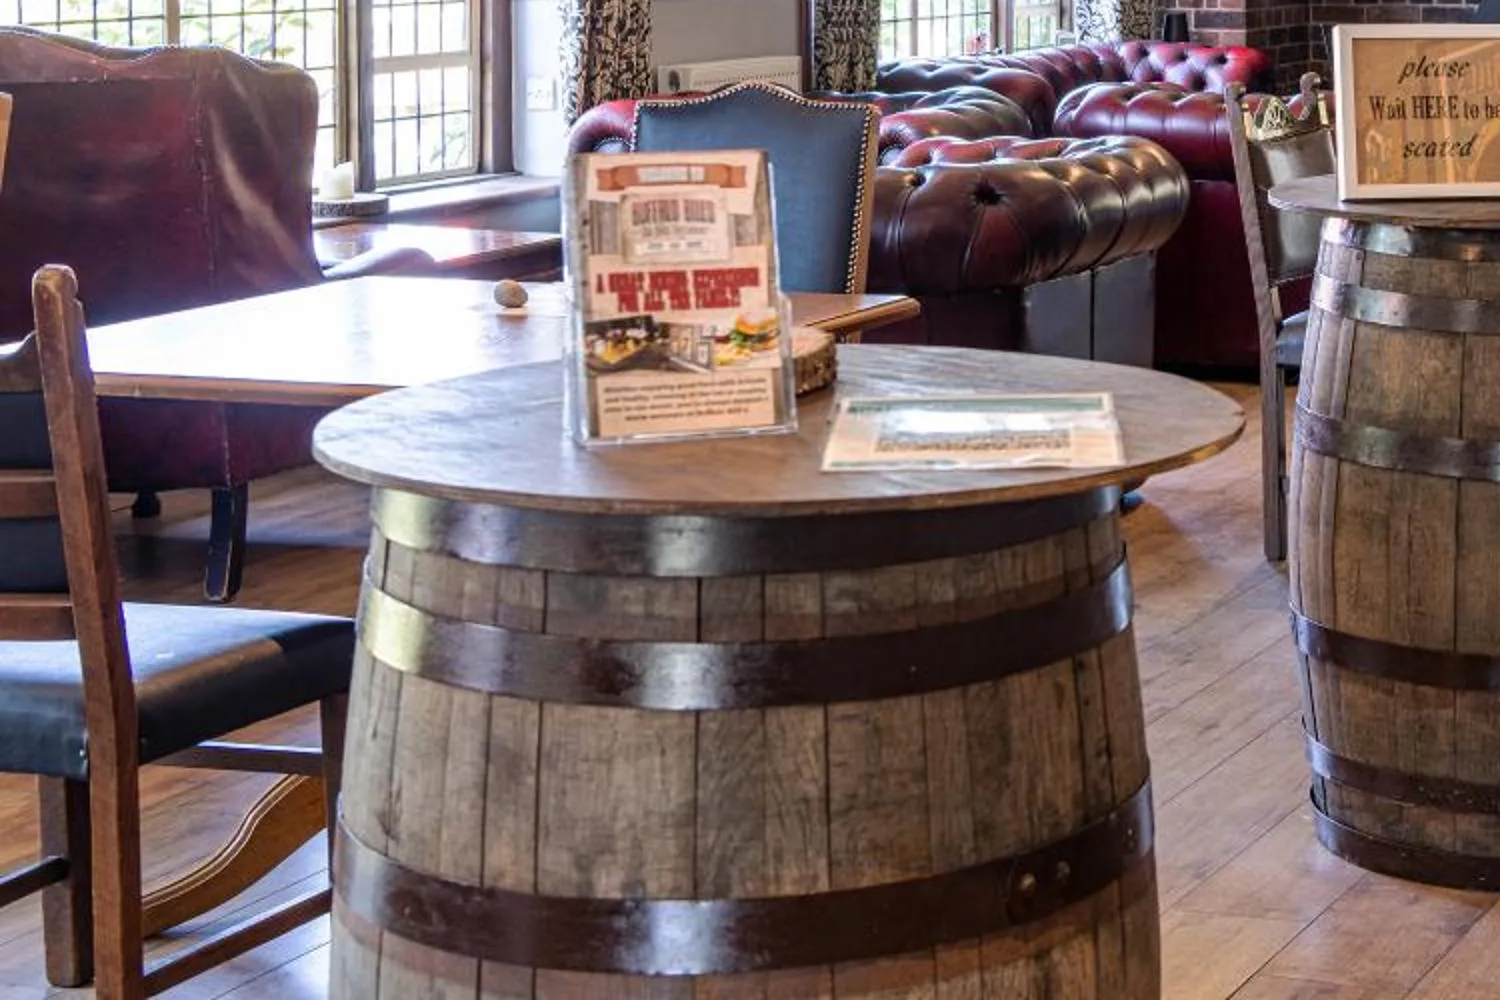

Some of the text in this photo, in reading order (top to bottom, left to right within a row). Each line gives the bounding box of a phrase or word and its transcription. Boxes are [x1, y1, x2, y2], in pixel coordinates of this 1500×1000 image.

[1397, 56, 1470, 84] please
[1369, 95, 1407, 121] Wait
[1411, 95, 1460, 120] HERE
[1463, 99, 1480, 120] to
[1403, 134, 1479, 158] seated
